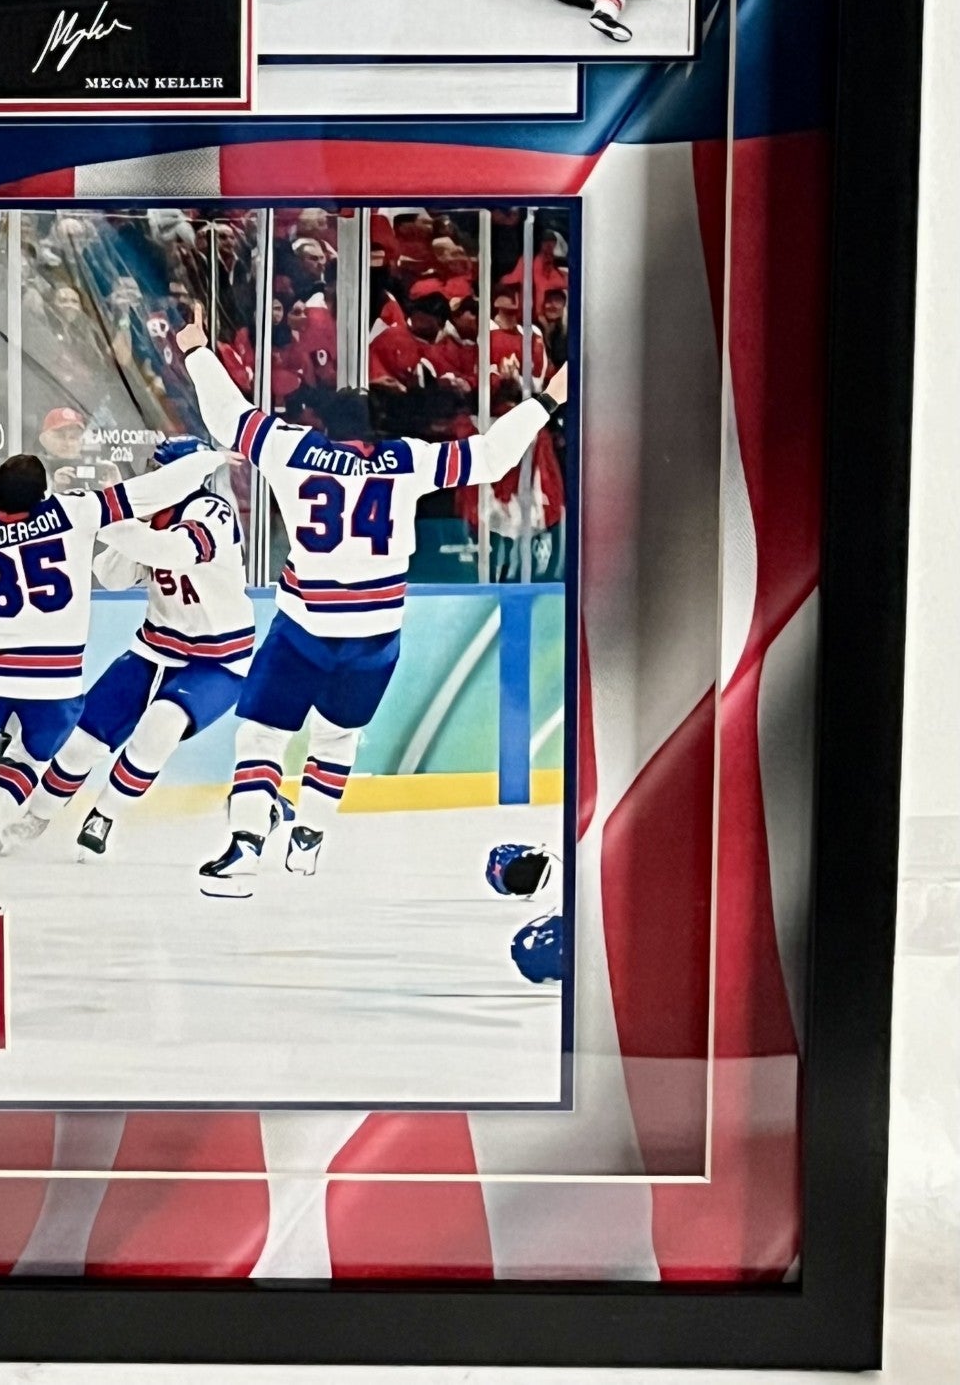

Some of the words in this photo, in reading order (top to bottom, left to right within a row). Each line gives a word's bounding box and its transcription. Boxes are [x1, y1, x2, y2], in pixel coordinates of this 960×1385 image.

[84, 76, 149, 89] MEGAN
[154, 76, 225, 89] KELLER
[204, 499, 232, 525] 72
[295, 474, 395, 556] 34
[151, 566, 201, 605] SA
